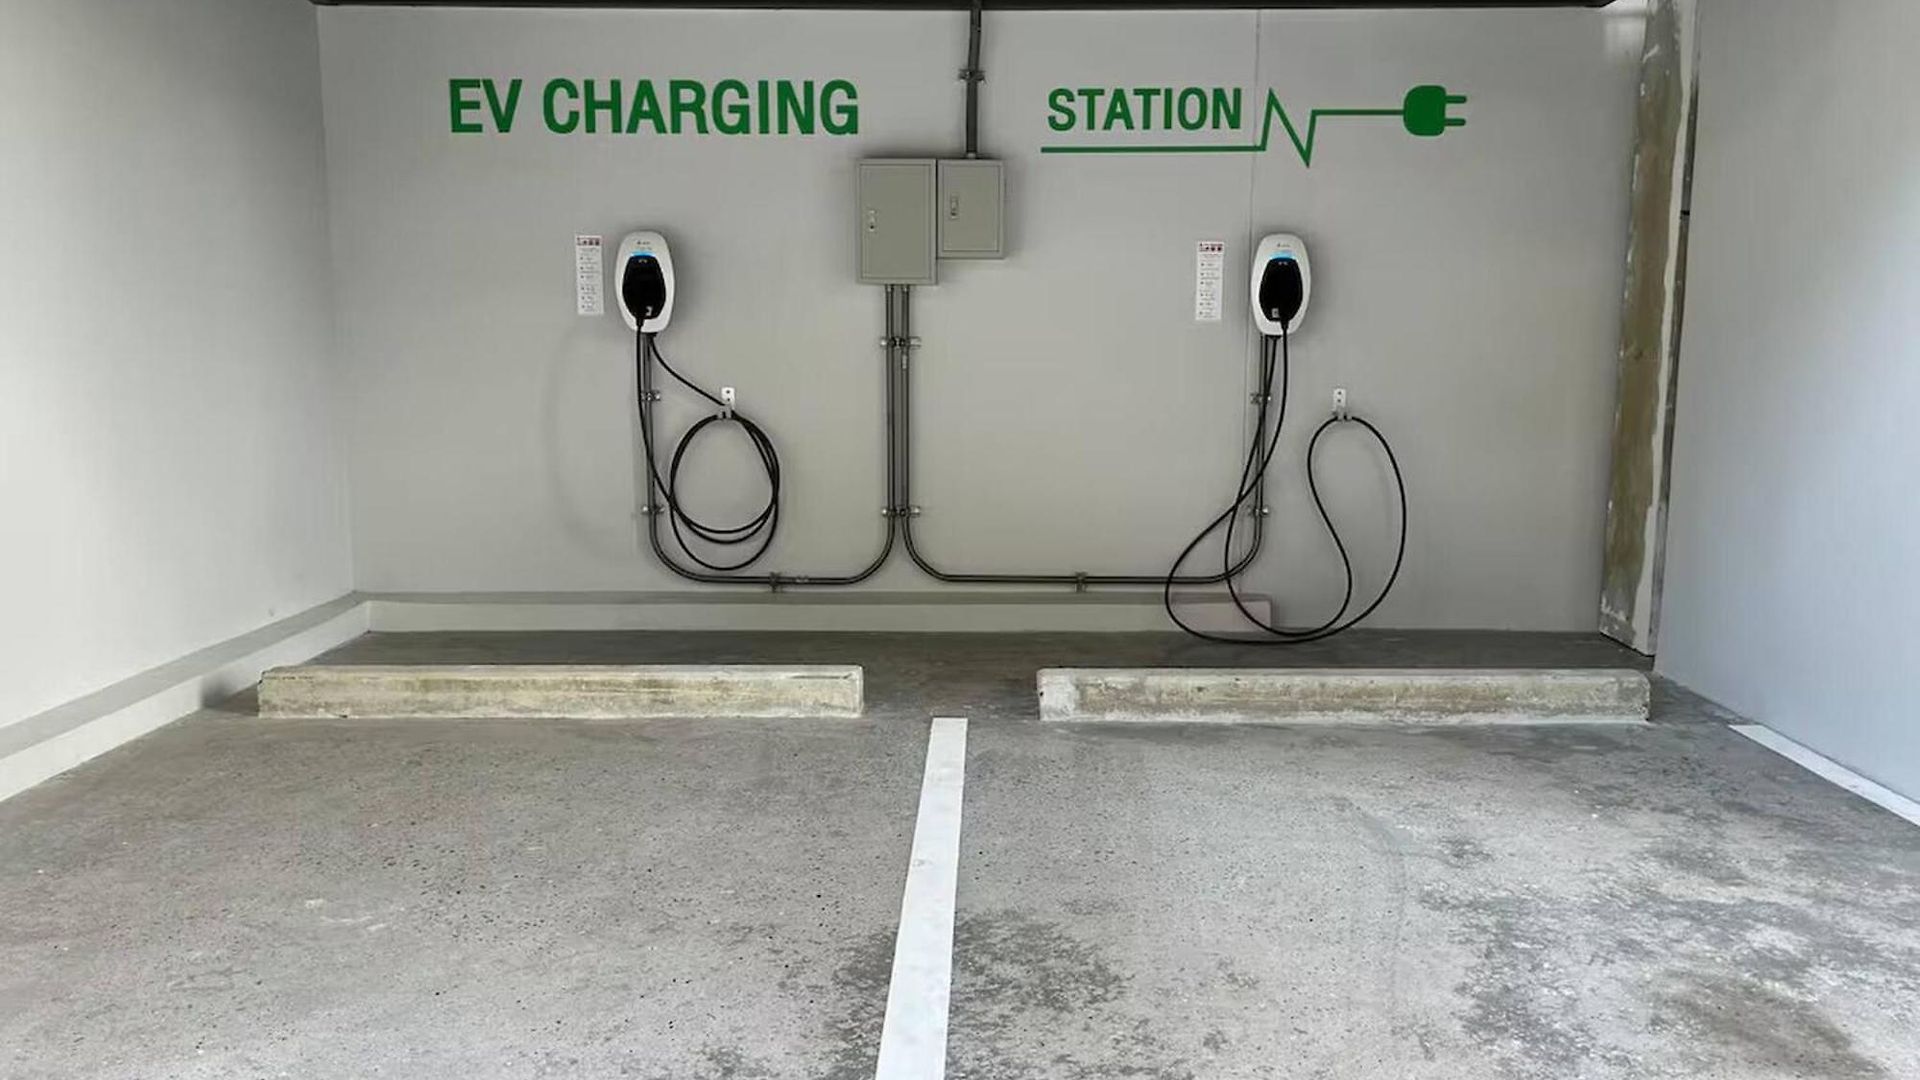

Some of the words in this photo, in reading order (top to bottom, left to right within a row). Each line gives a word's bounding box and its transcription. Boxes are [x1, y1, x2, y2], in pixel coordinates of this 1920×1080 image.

[449, 78, 523, 134] EV
[543, 78, 859, 135] CHARGING
[1047, 86, 1242, 131] STATION
